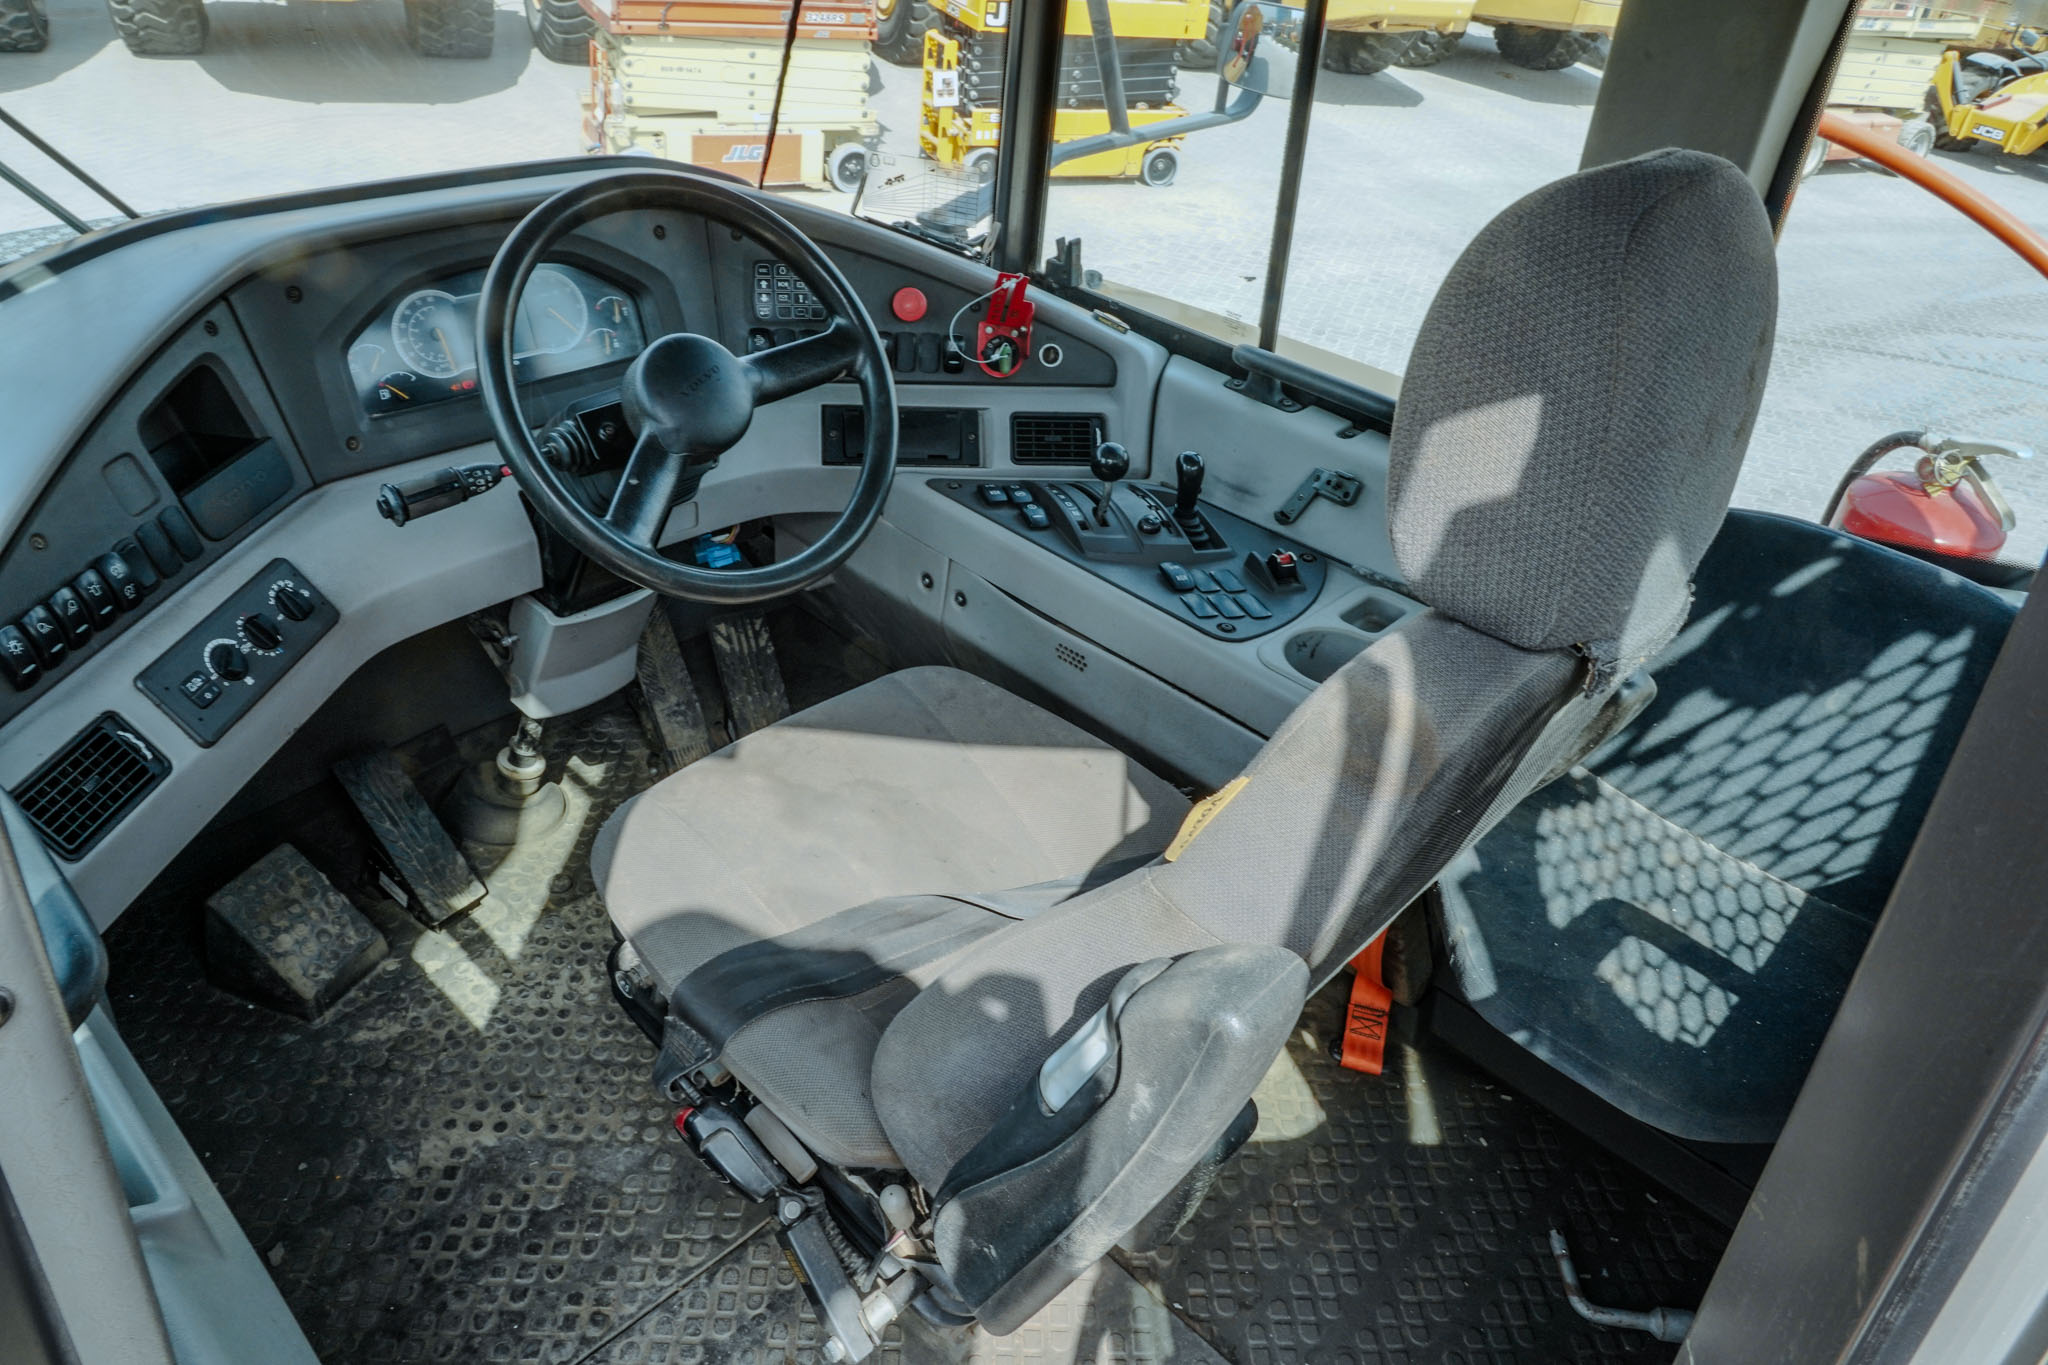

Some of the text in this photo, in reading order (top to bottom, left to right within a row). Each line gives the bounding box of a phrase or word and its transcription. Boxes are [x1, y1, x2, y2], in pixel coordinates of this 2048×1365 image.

[1972, 124, 2005, 140] JCB
[722, 144, 766, 163] JLG
[680, 364, 721, 396] VOLVO
